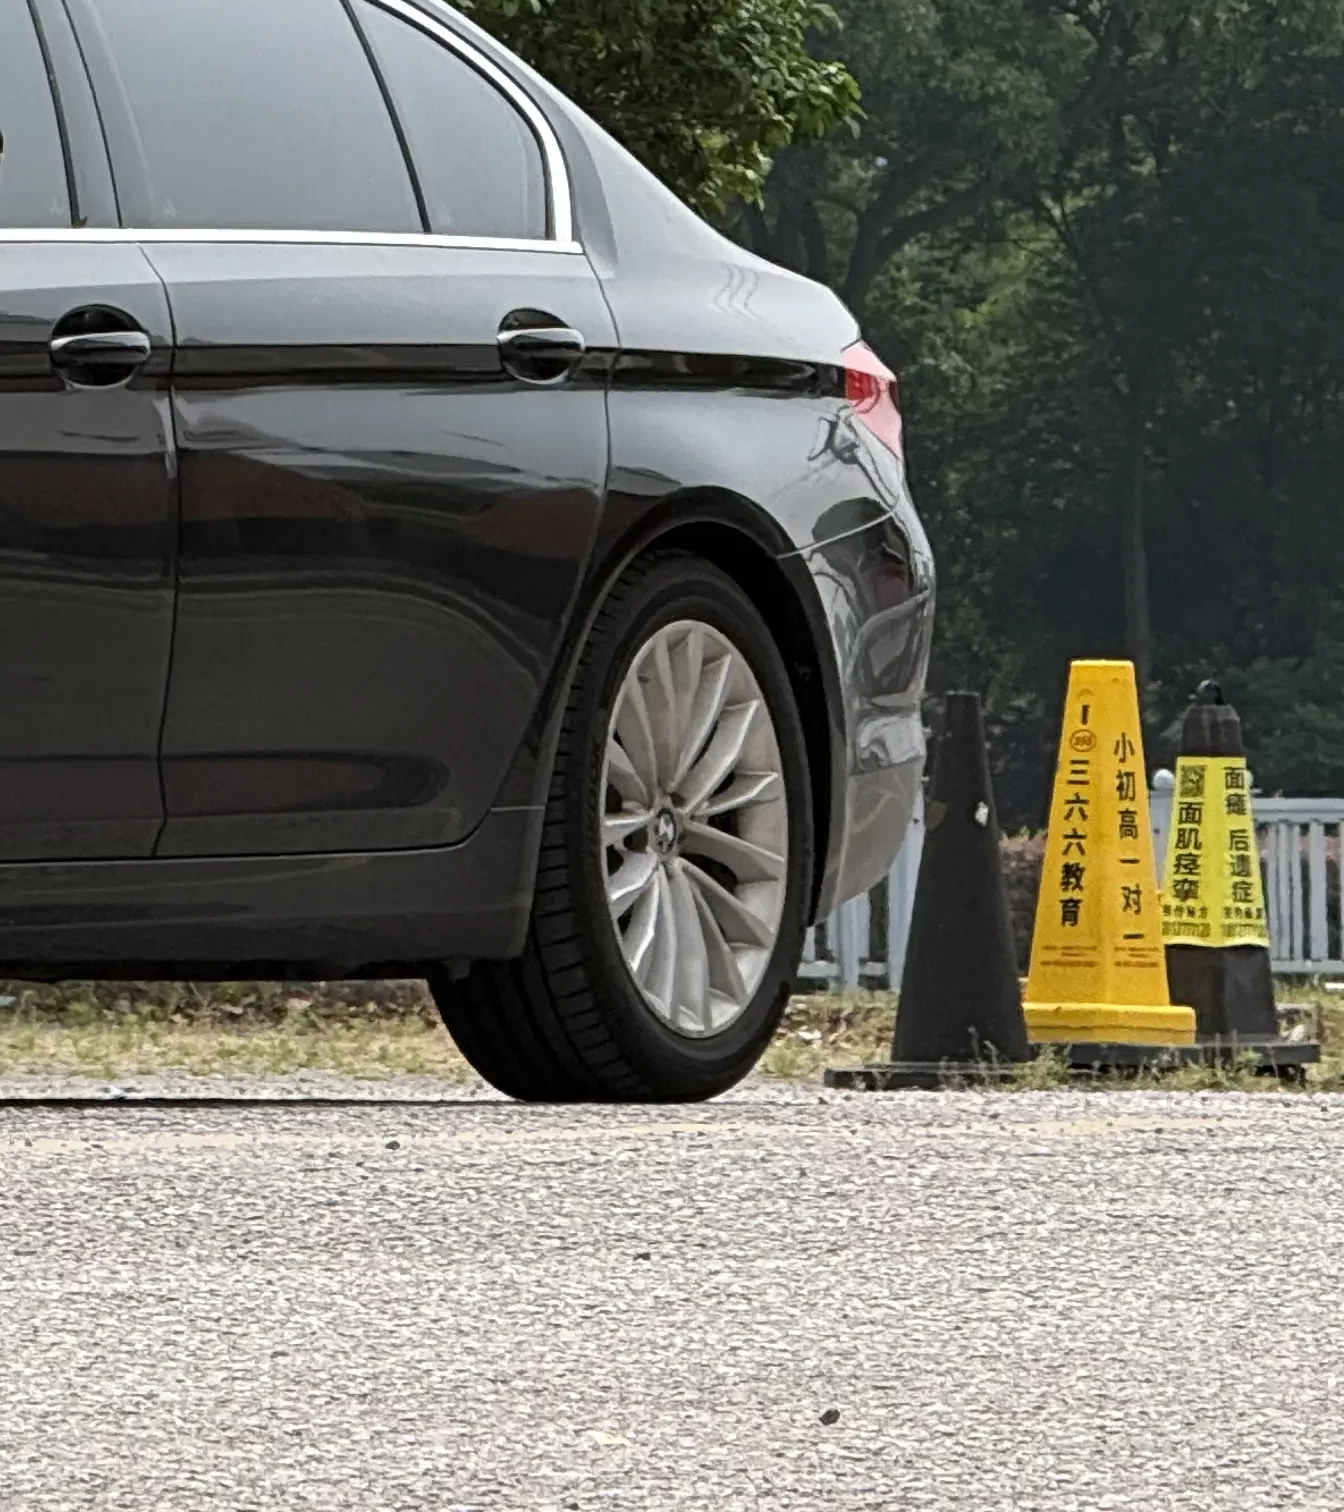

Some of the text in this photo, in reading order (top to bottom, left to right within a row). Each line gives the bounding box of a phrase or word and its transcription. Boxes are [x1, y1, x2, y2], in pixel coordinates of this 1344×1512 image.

[1059, 759, 1091, 927] 三六六教育
[1114, 732, 1145, 940] 小初高一对一
